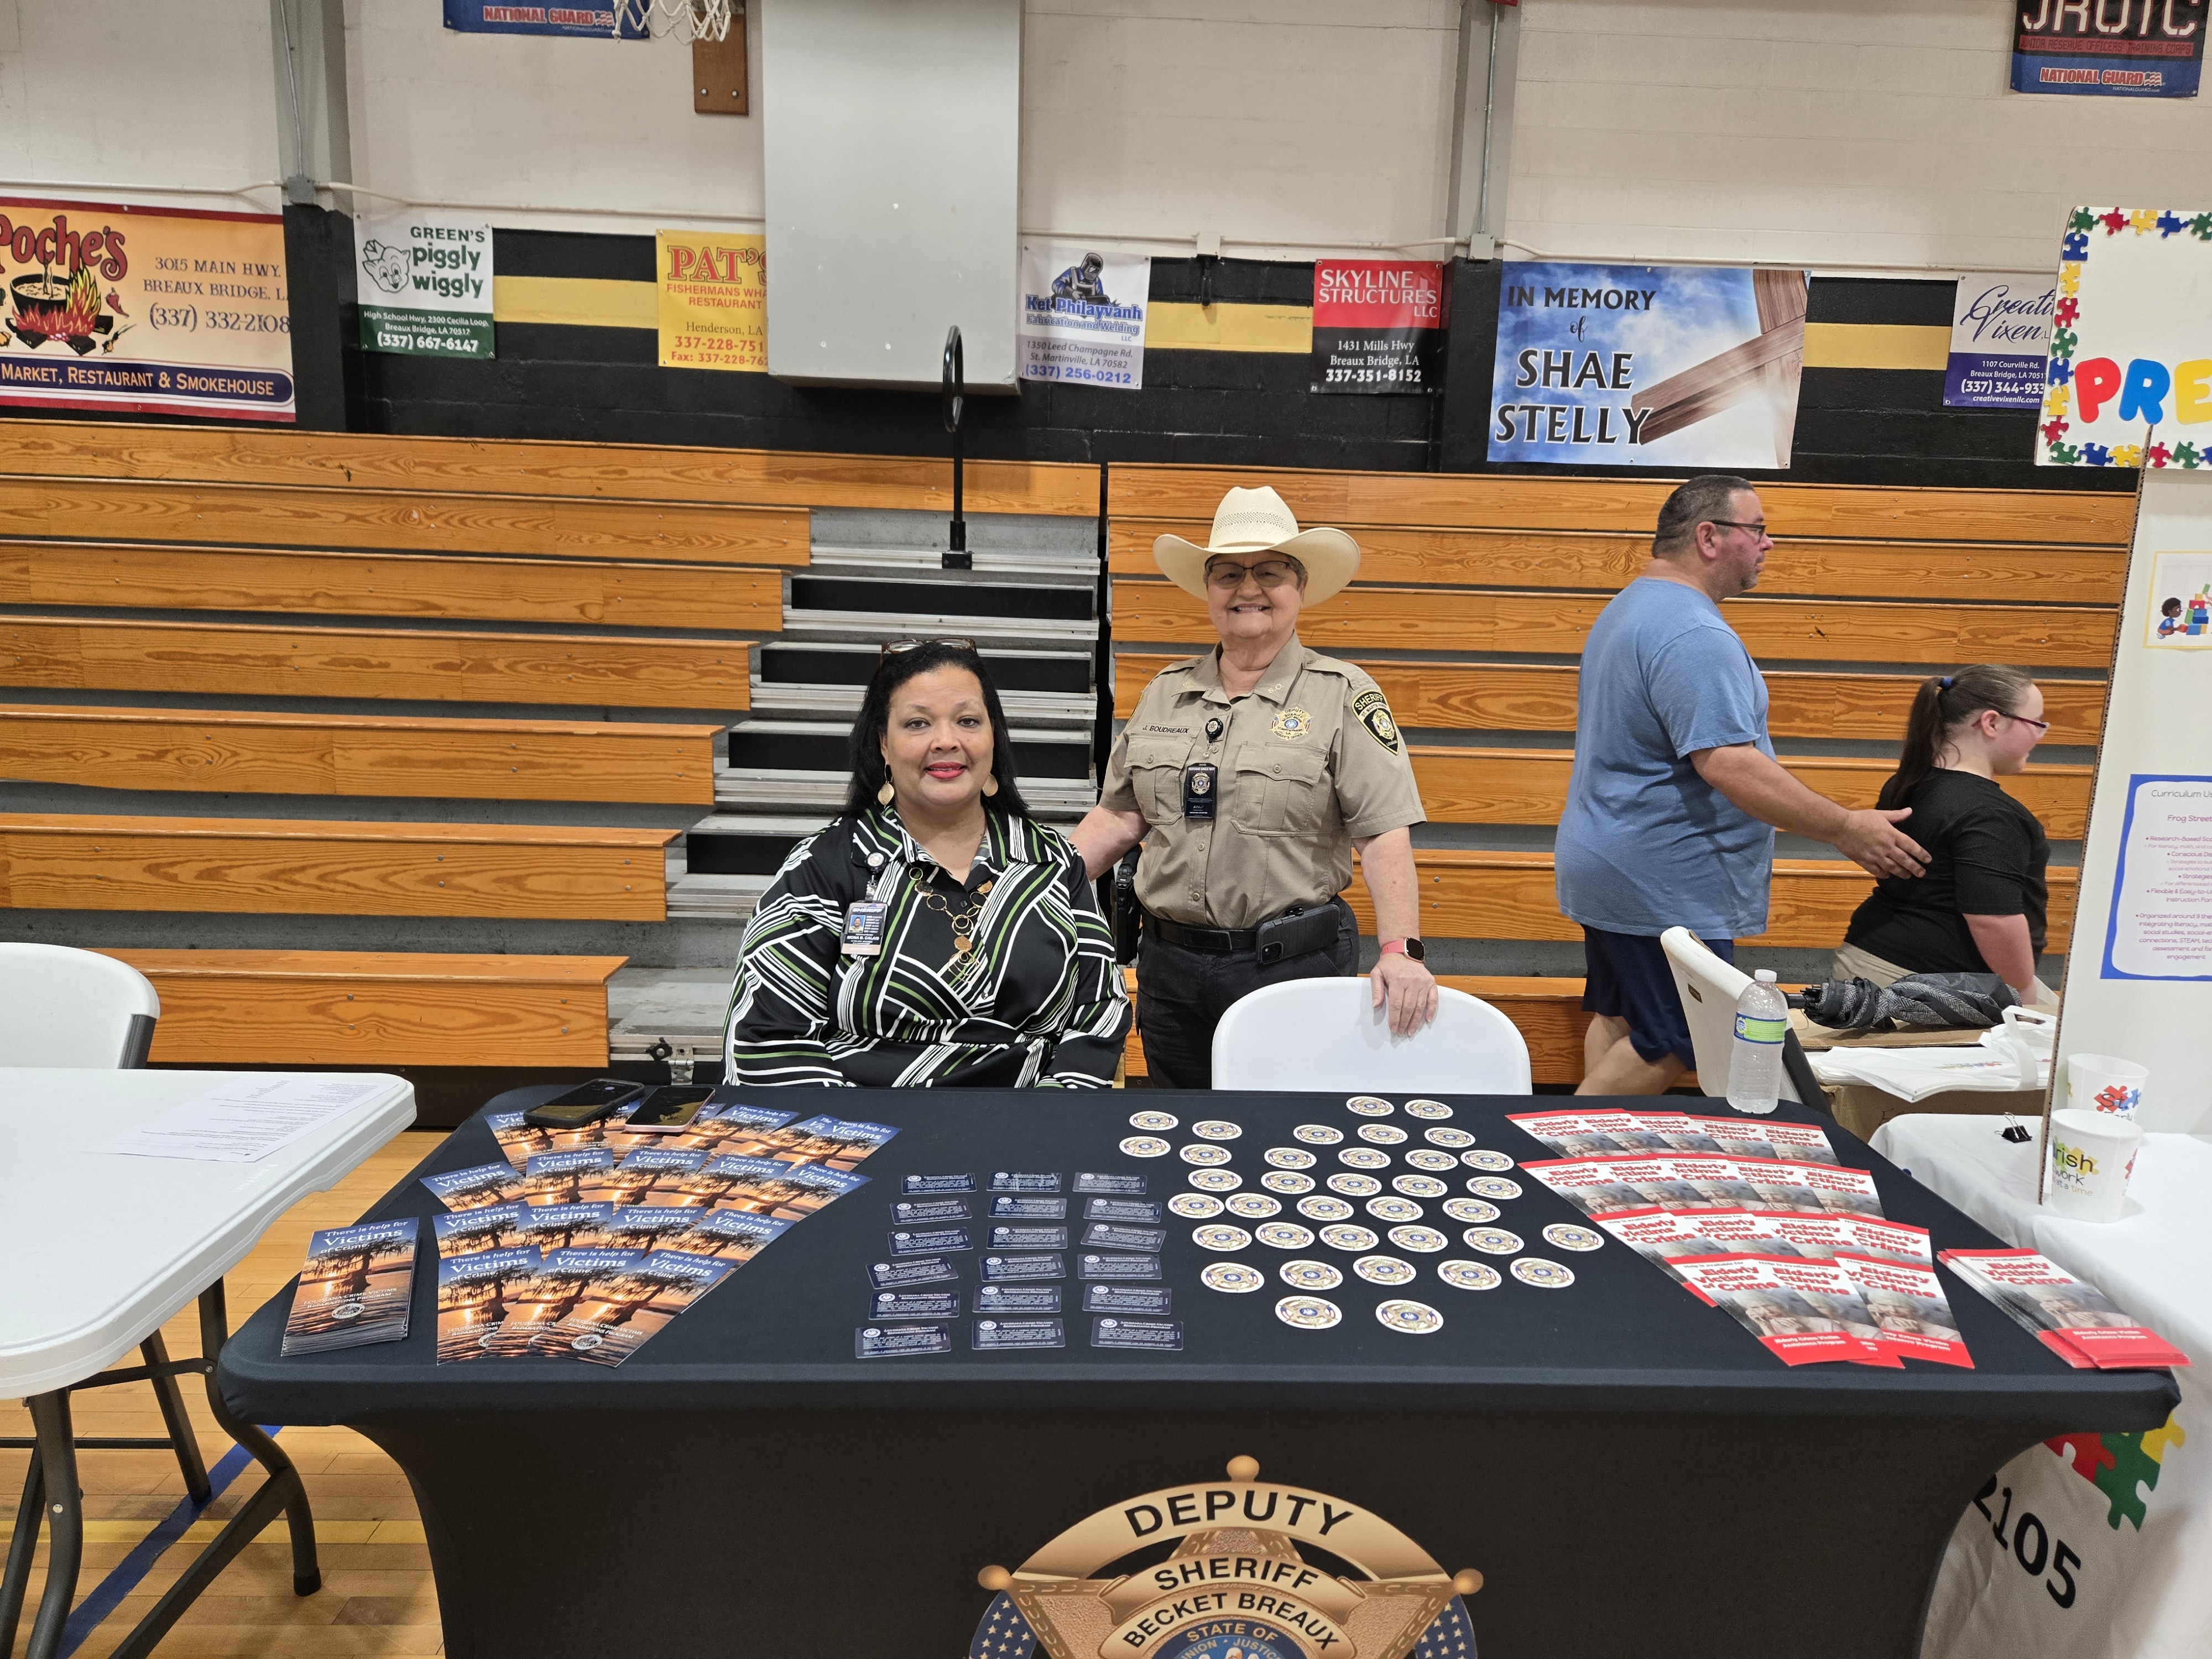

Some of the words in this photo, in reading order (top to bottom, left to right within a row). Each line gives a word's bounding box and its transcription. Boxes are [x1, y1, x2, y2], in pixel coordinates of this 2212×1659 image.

[483, 6, 547, 23] NATIONAL
[548, 8, 594, 26] GUARD
[2048, 39, 2083, 50] RESERVE
[2039, 67, 2100, 84] NATIONAL
[2101, 70, 2144, 86] GUARD
[410, 227, 486, 242] GREEN'S
[413, 242, 481, 271] piggly
[155, 257, 187, 271] 3015
[194, 259, 236, 275] MAIN
[243, 262, 281, 278] HWY.
[412, 270, 484, 299] wiggly
[1321, 269, 1413, 289] SKYLINE
[143, 279, 203, 295] BREAUX
[276, 287, 288, 301] L
[667, 284, 740, 296] FISHERMANS
[1318, 288, 1437, 304] STRUCTURES
[1507, 286, 1534, 306] IN
[1543, 287, 1656, 311] MEMORY
[689, 297, 763, 309] RESTAURANT
[1025, 294, 1051, 311] Ket
[1055, 297, 1143, 322] Philayvanh
[1414, 306, 1437, 317] LLC
[149, 302, 198, 332] (337)
[205, 308, 290, 334] 332-2108
[364, 310, 382, 320] High
[383, 312, 408, 321] School
[427, 316, 446, 324] 2300
[1027, 314, 1079, 328] Fabrication
[1081, 320, 1099, 330] and
[1100, 321, 1140, 336] Welding
[385, 322, 411, 331] Breaux
[686, 322, 745, 336] Henderson,
[748, 325, 763, 336] LA
[1570, 316, 1587, 342] of
[377, 331, 414, 350] (337)
[416, 336, 479, 353] 667-6147
[1027, 341, 1046, 349] 1350
[1048, 342, 1066, 351] Leed
[1068, 344, 1118, 357] Champagne
[1120, 348, 1133, 358] Rd.
[1338, 340, 1360, 350] 1431
[1363, 341, 1388, 351] Mills
[1391, 341, 1415, 352] Hwy
[671, 351, 693, 361] Fax:
[1042, 354, 1088, 366] Martinville,
[1102, 360, 1128, 369] 70582
[1330, 356, 1364, 366] Breaux
[1367, 356, 1402, 368] Bridge,
[1405, 356, 1419, 366] LA
[1026, 364, 1061, 379] (337)
[1065, 367, 1131, 384] 256-0212
[1326, 369, 1421, 382] 337-351-8152
[1516, 348, 1635, 391] SHAE
[1, 363, 63, 385] MARKET,
[68, 366, 153, 387] RESTAURANT
[158, 372, 171, 388] &
[176, 373, 275, 396] SMOKEHOUSE
[1961, 379, 1992, 394] (337)
[1973, 395, 2039, 403] creativevixenllc.com
[2074, 357, 2212, 425] PRE
[1494, 404, 1654, 446] STELLY
[2168, 815, 2186, 823] Frog
[2100, 1093, 2128, 1109] St.
[2070, 1184, 2093, 1196] time
[323, 1229, 403, 1246] Victims
[650, 1258, 713, 1276] Victims
[2007, 1277, 2074, 1285] Crime
[1124, 1490, 1354, 1538] DEPUTY
[1154, 1557, 1319, 1592] SHERIFF
[1123, 1592, 1228, 1648] BECKET
[1238, 1593, 1340, 1650] BREAUX
[1187, 1623, 1246, 1642] STATE
[1253, 1627, 1279, 1641] OF
[1233, 1638, 1281, 1659] JUSTIC
